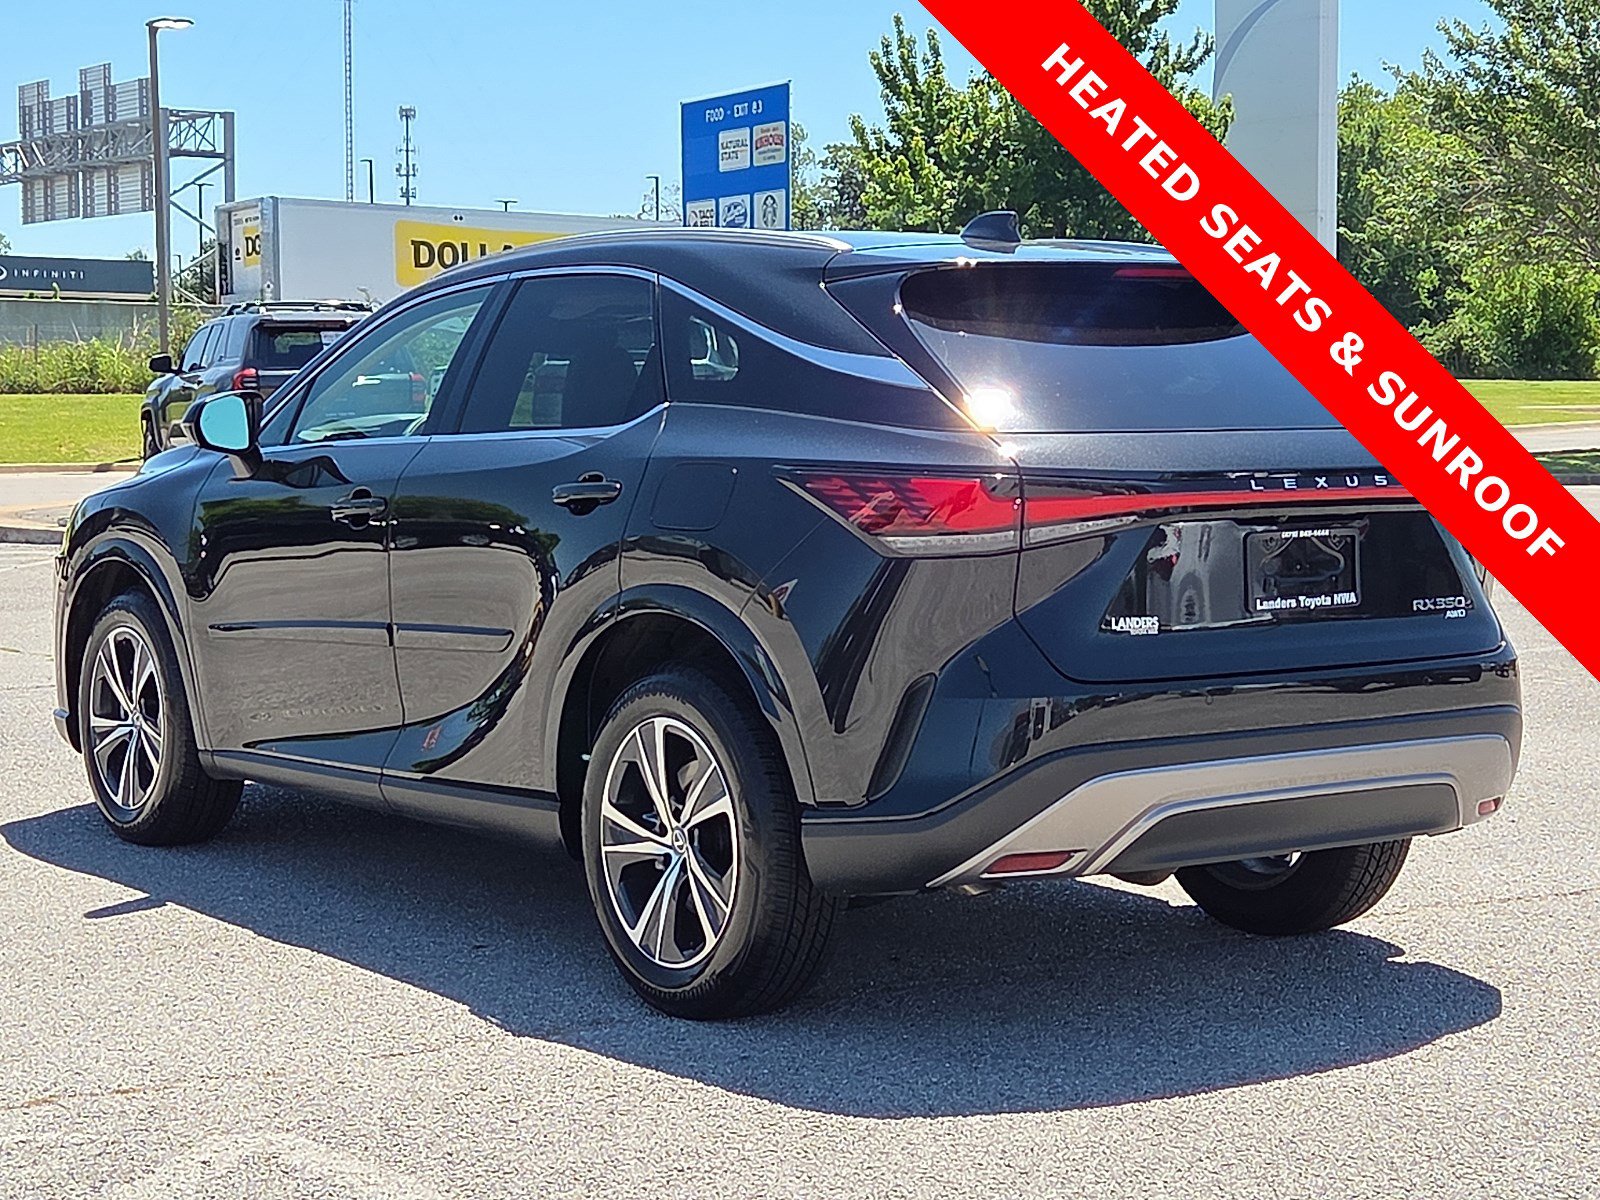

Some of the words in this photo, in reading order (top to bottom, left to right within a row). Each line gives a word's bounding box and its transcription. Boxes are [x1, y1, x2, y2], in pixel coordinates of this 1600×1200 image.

[706, 107, 724, 123] FOOD
[720, 138, 748, 150] NATURAL
[410, 239, 514, 270] DOLL
[13, 268, 85, 280] INFINITI
[1250, 475, 1388, 491] LEXUS
[1256, 597, 1297, 610] Landers
[1298, 594, 1332, 610] Toyota
[1333, 591, 1357, 606] NWA
[1444, 608, 1467, 620] AWD
[1111, 615, 1160, 632] LANDERS
